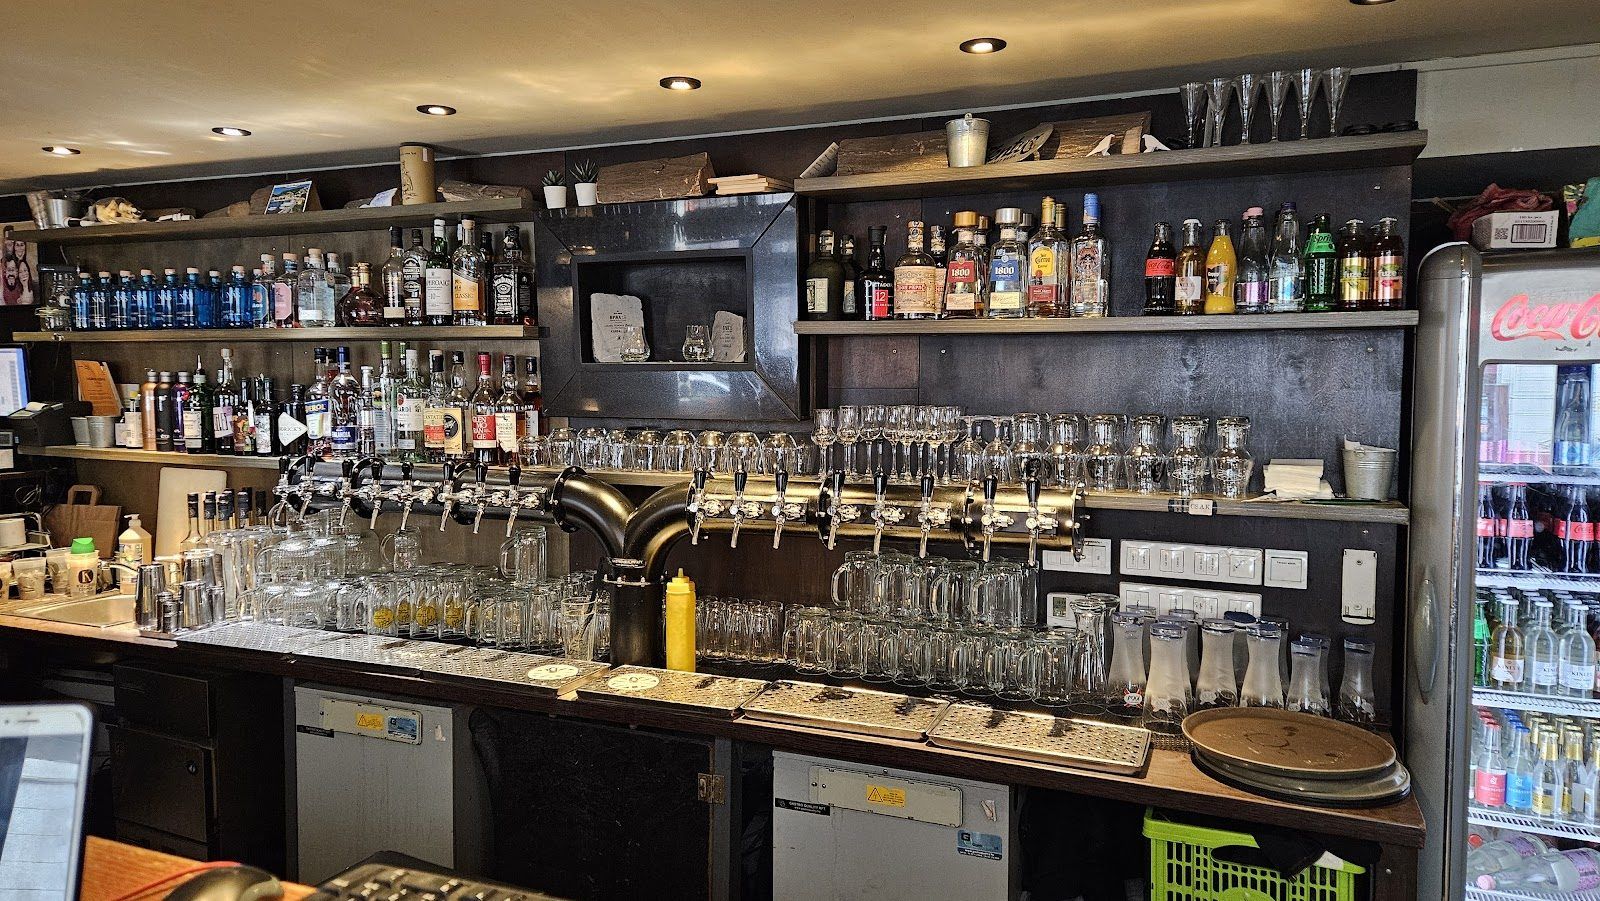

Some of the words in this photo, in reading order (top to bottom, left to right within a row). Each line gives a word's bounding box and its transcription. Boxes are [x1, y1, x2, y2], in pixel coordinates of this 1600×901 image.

[951, 268, 970, 277] 1800
[995, 266, 1015, 275] 1800
[875, 291, 886, 302] 12
[1491, 293, 1600, 342] Coca-C
